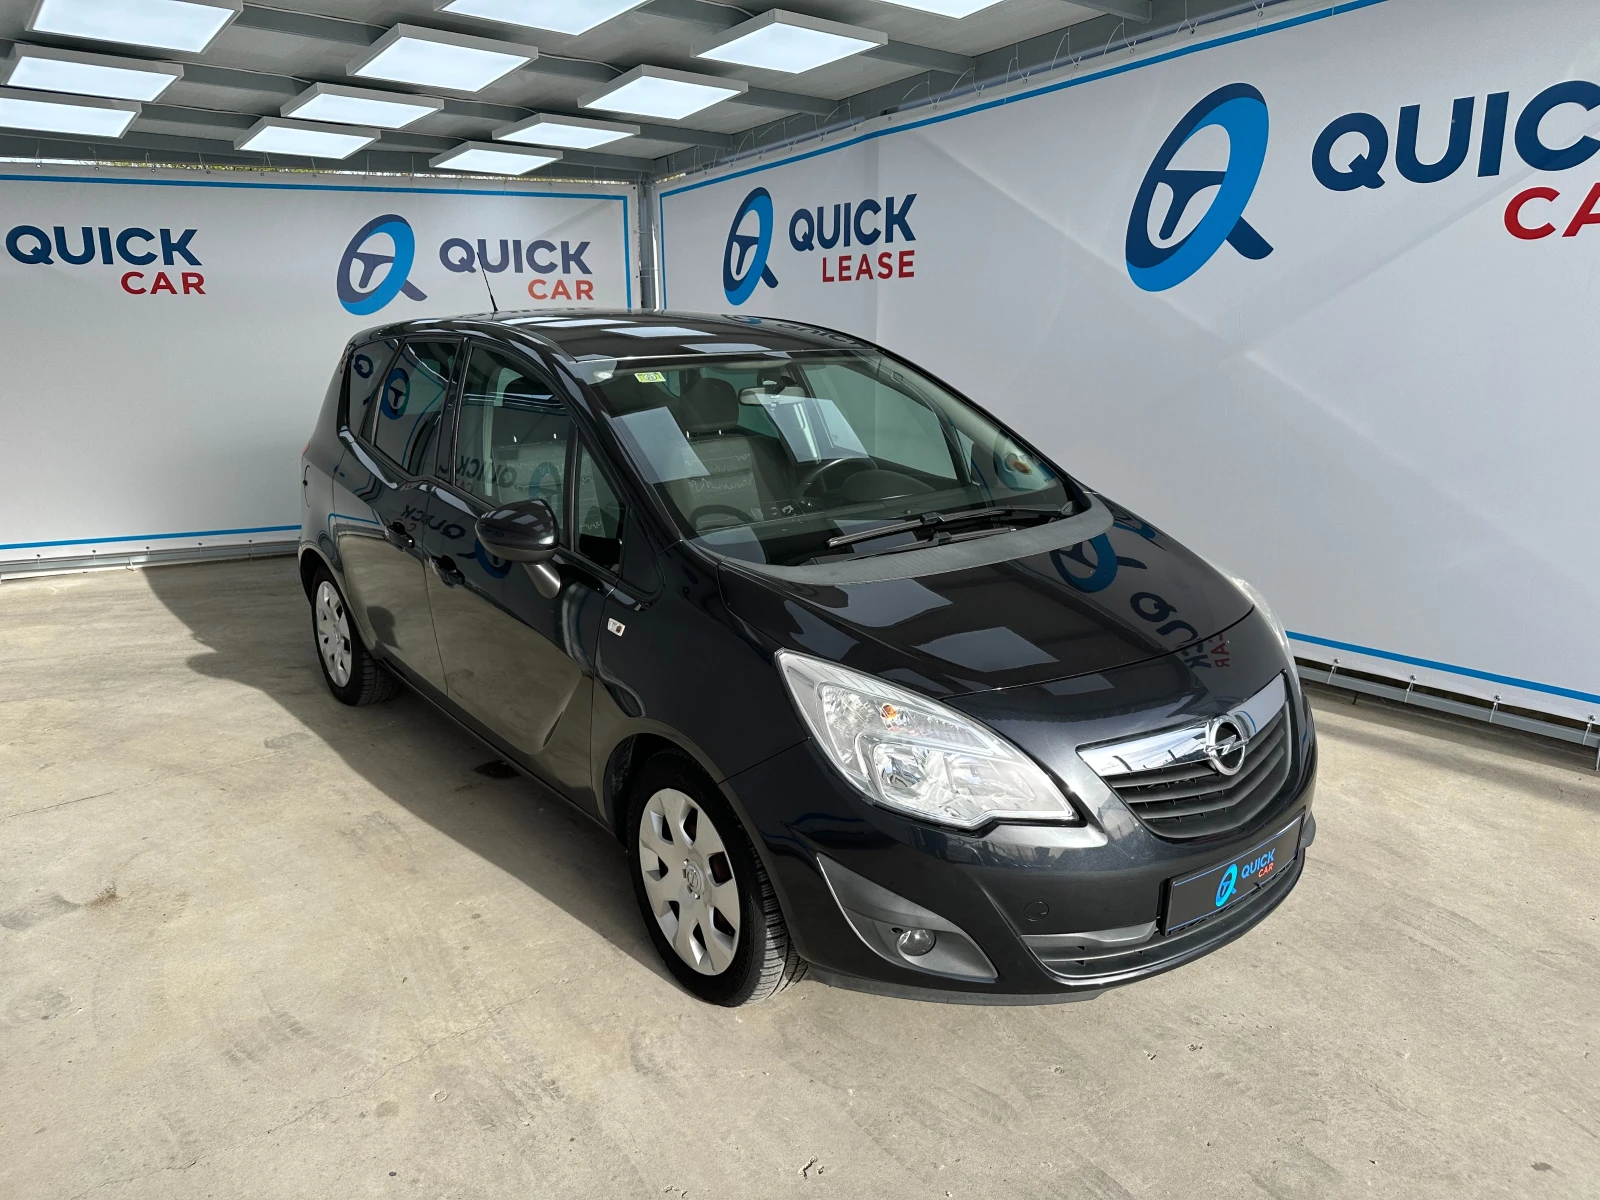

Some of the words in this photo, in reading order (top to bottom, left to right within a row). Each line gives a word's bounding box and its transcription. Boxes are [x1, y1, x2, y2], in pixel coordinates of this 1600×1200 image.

[789, 193, 918, 252] QUICK
[5, 225, 203, 266] QUICK
[439, 237, 593, 275] QUICK
[822, 249, 916, 283] LEASE
[121, 271, 206, 295] CAR
[527, 278, 594, 301] CAR
[1241, 847, 1276, 879] QUICK
[1258, 862, 1274, 878] CAR
